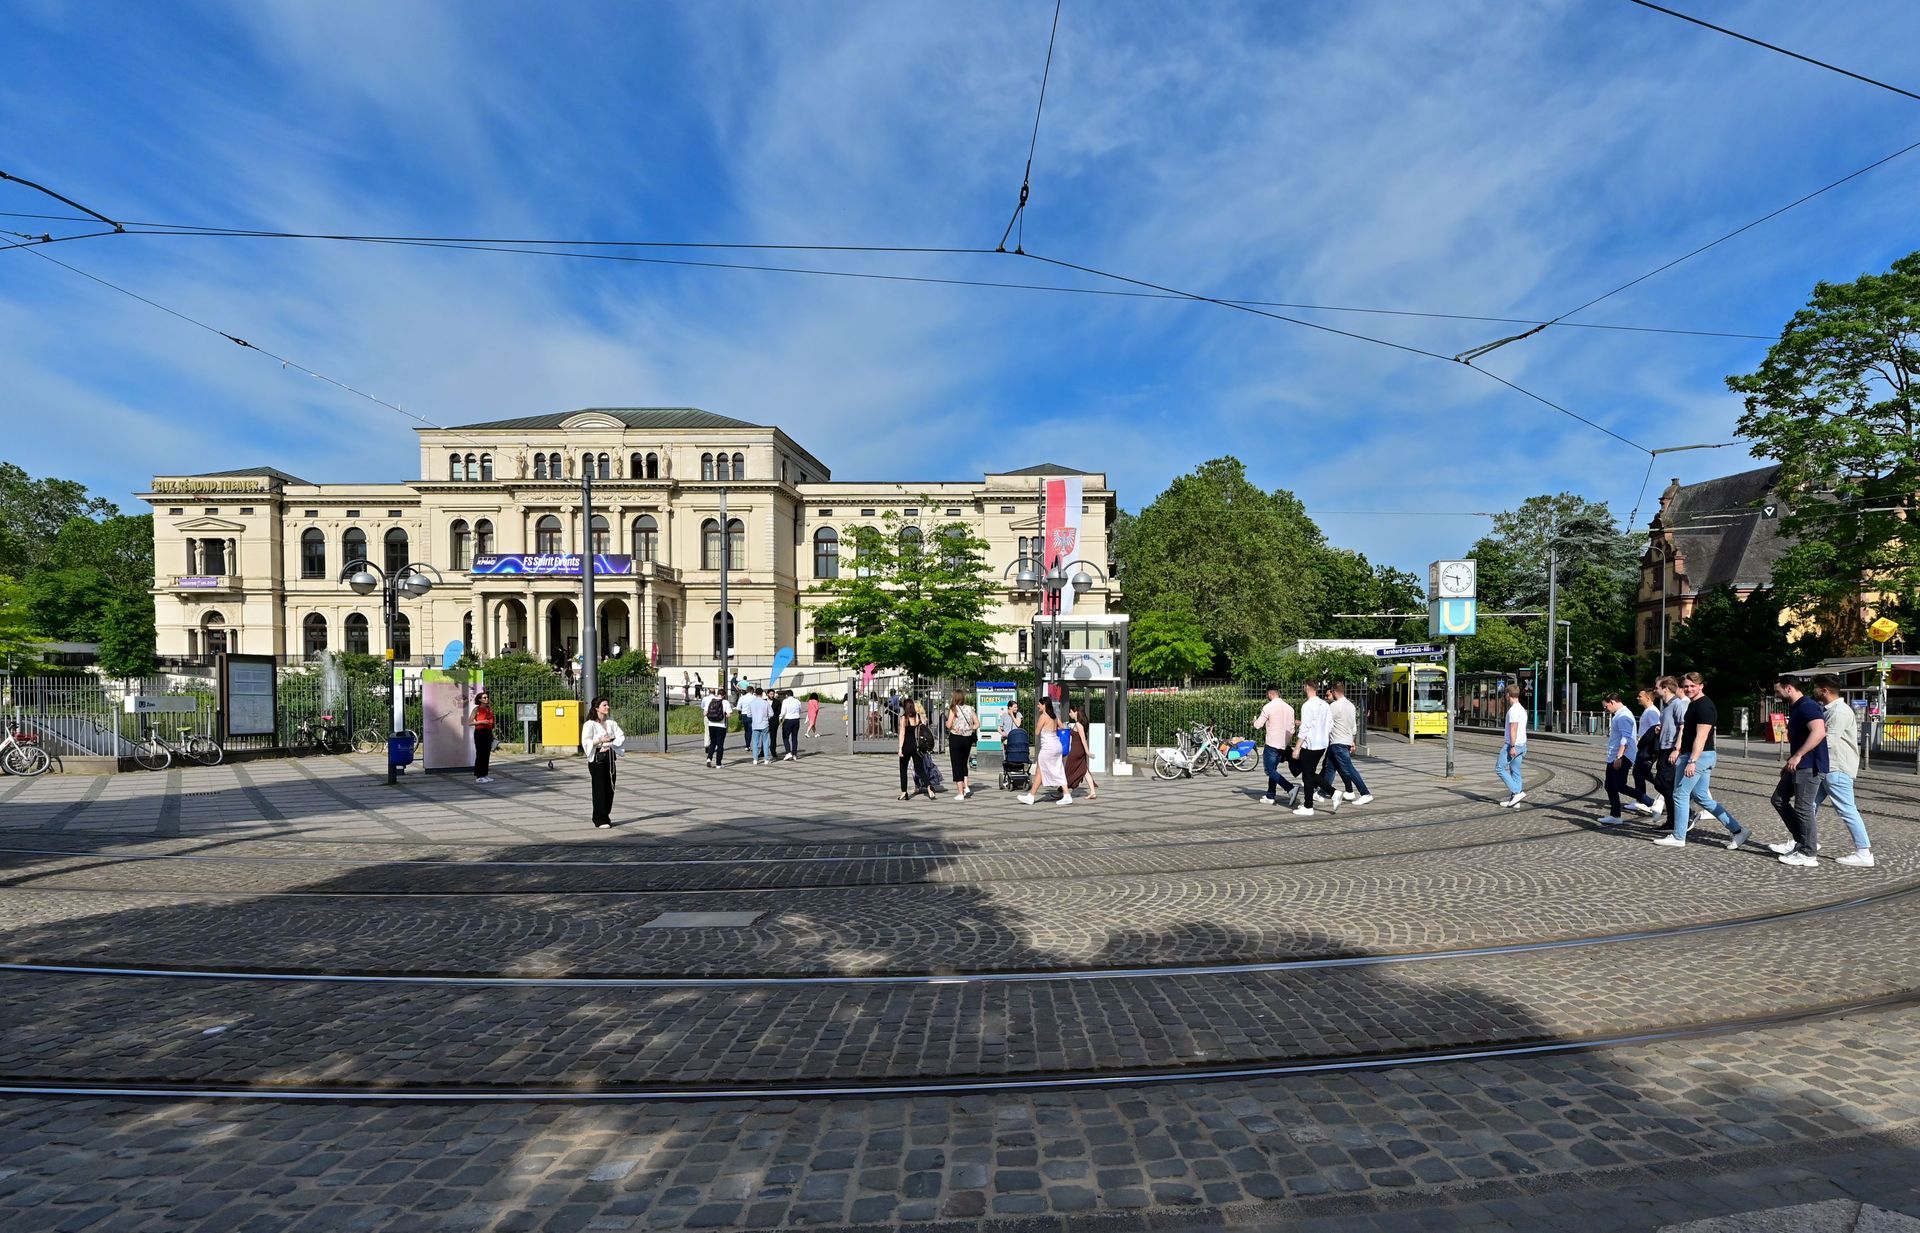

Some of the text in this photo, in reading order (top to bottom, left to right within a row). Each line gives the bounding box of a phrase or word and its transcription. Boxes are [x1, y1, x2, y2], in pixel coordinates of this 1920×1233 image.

[151, 479, 259, 491] FRITZ RÉMOND THEATER
[523, 556, 581, 567] FS Spirit Events
[1443, 601, 1471, 632] U
